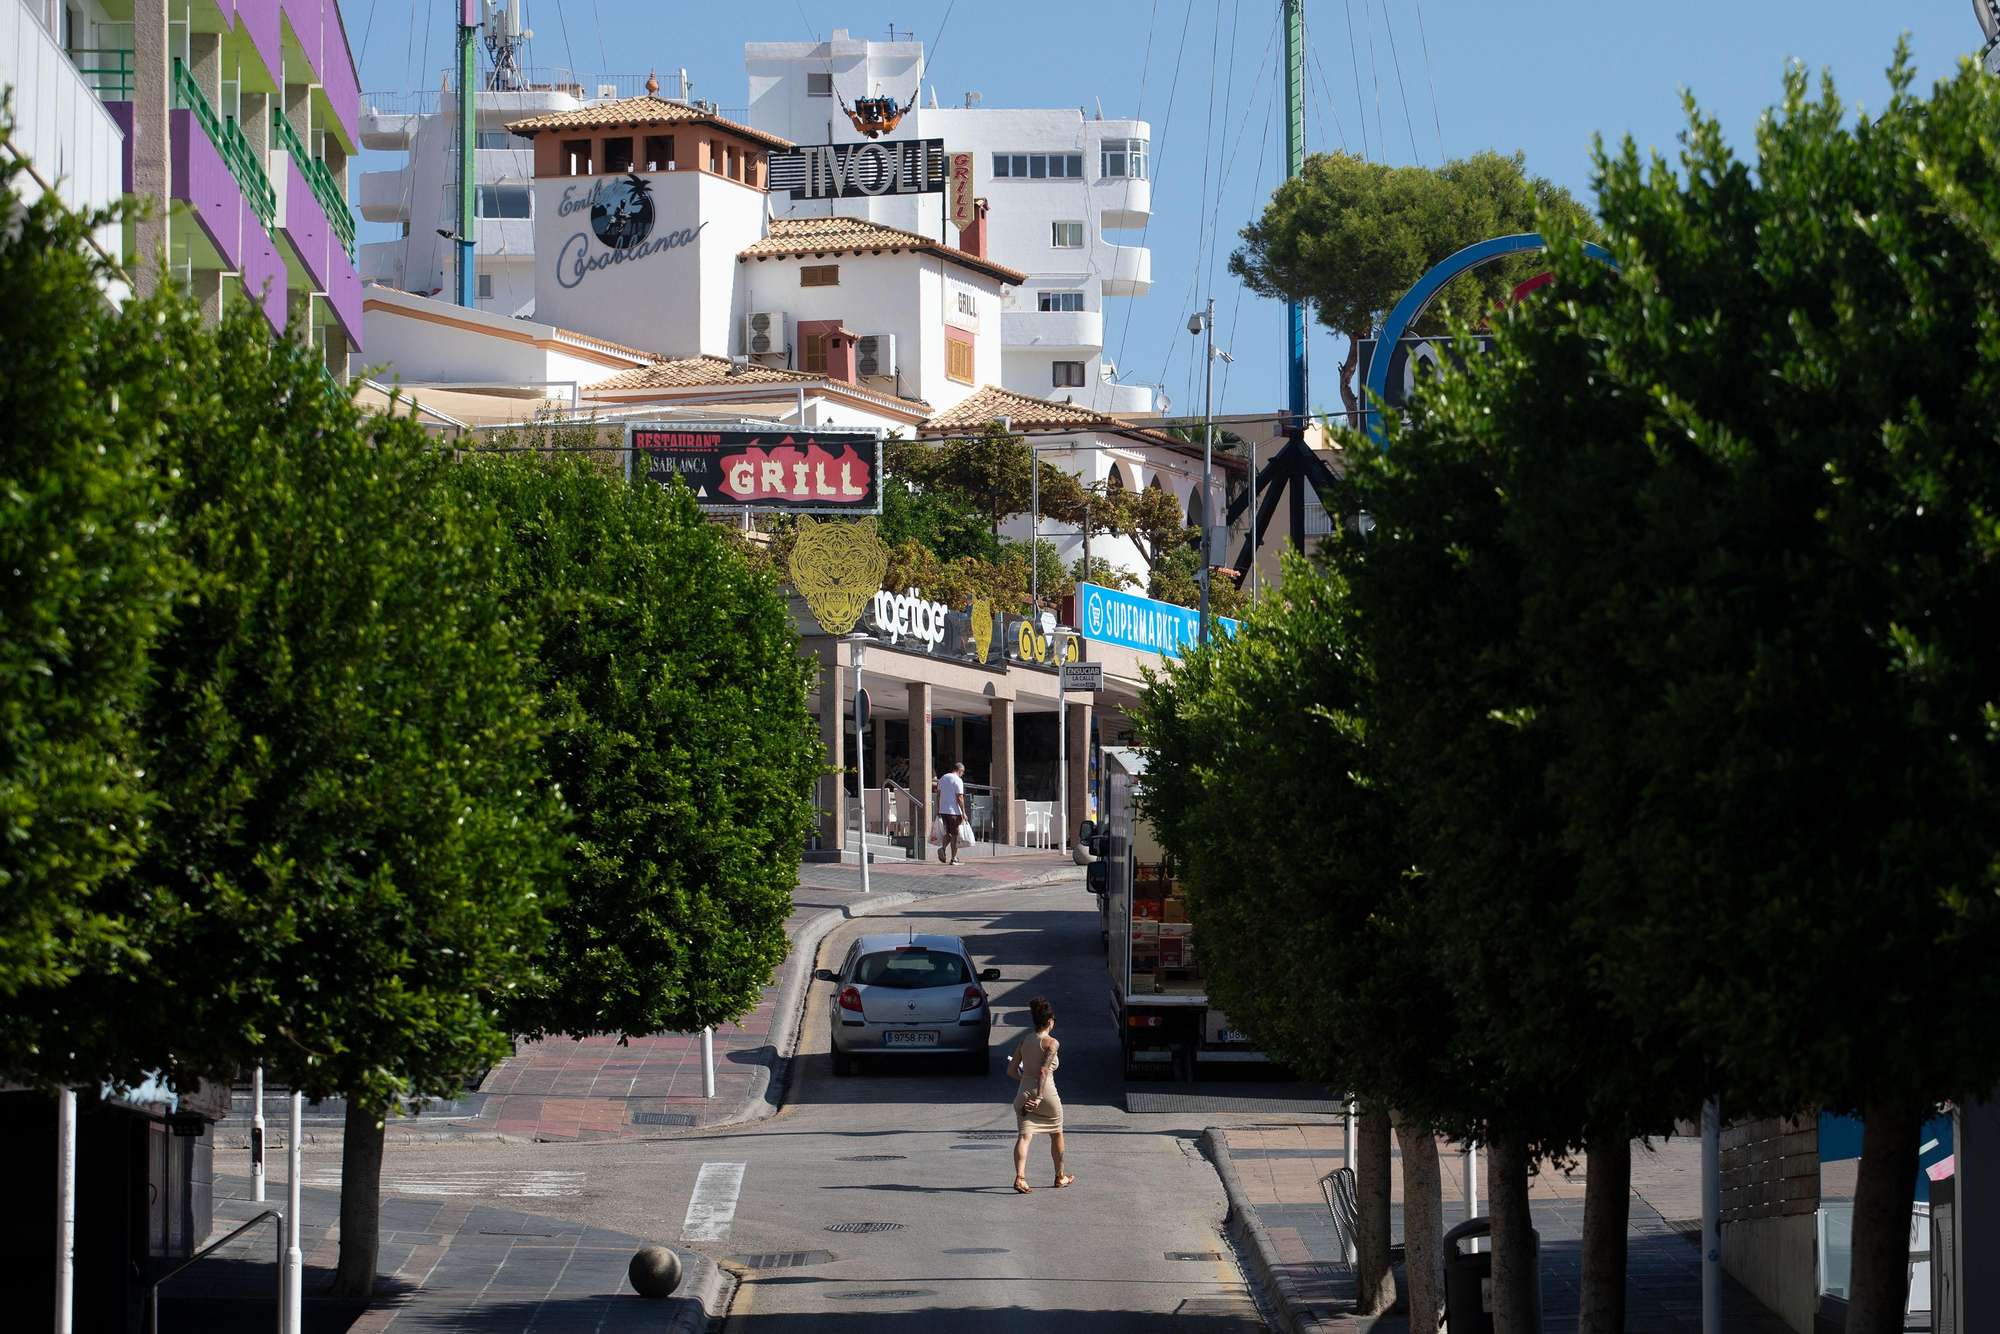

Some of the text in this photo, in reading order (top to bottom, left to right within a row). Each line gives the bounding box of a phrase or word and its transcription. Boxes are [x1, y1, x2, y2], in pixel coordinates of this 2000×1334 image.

[800, 140, 928, 198] TIVOLI
[953, 154, 970, 219] GRILL
[556, 221, 709, 289] Casablanca
[958, 291, 977, 318] GRILL
[636, 432, 721, 452] RESTAURANT
[729, 459, 863, 496] GRILL
[1106, 599, 1180, 653] SUPERMARKET
[1067, 667, 1100, 675] ENSUCIAR
[894, 1033, 935, 1042] 9758 FFN
